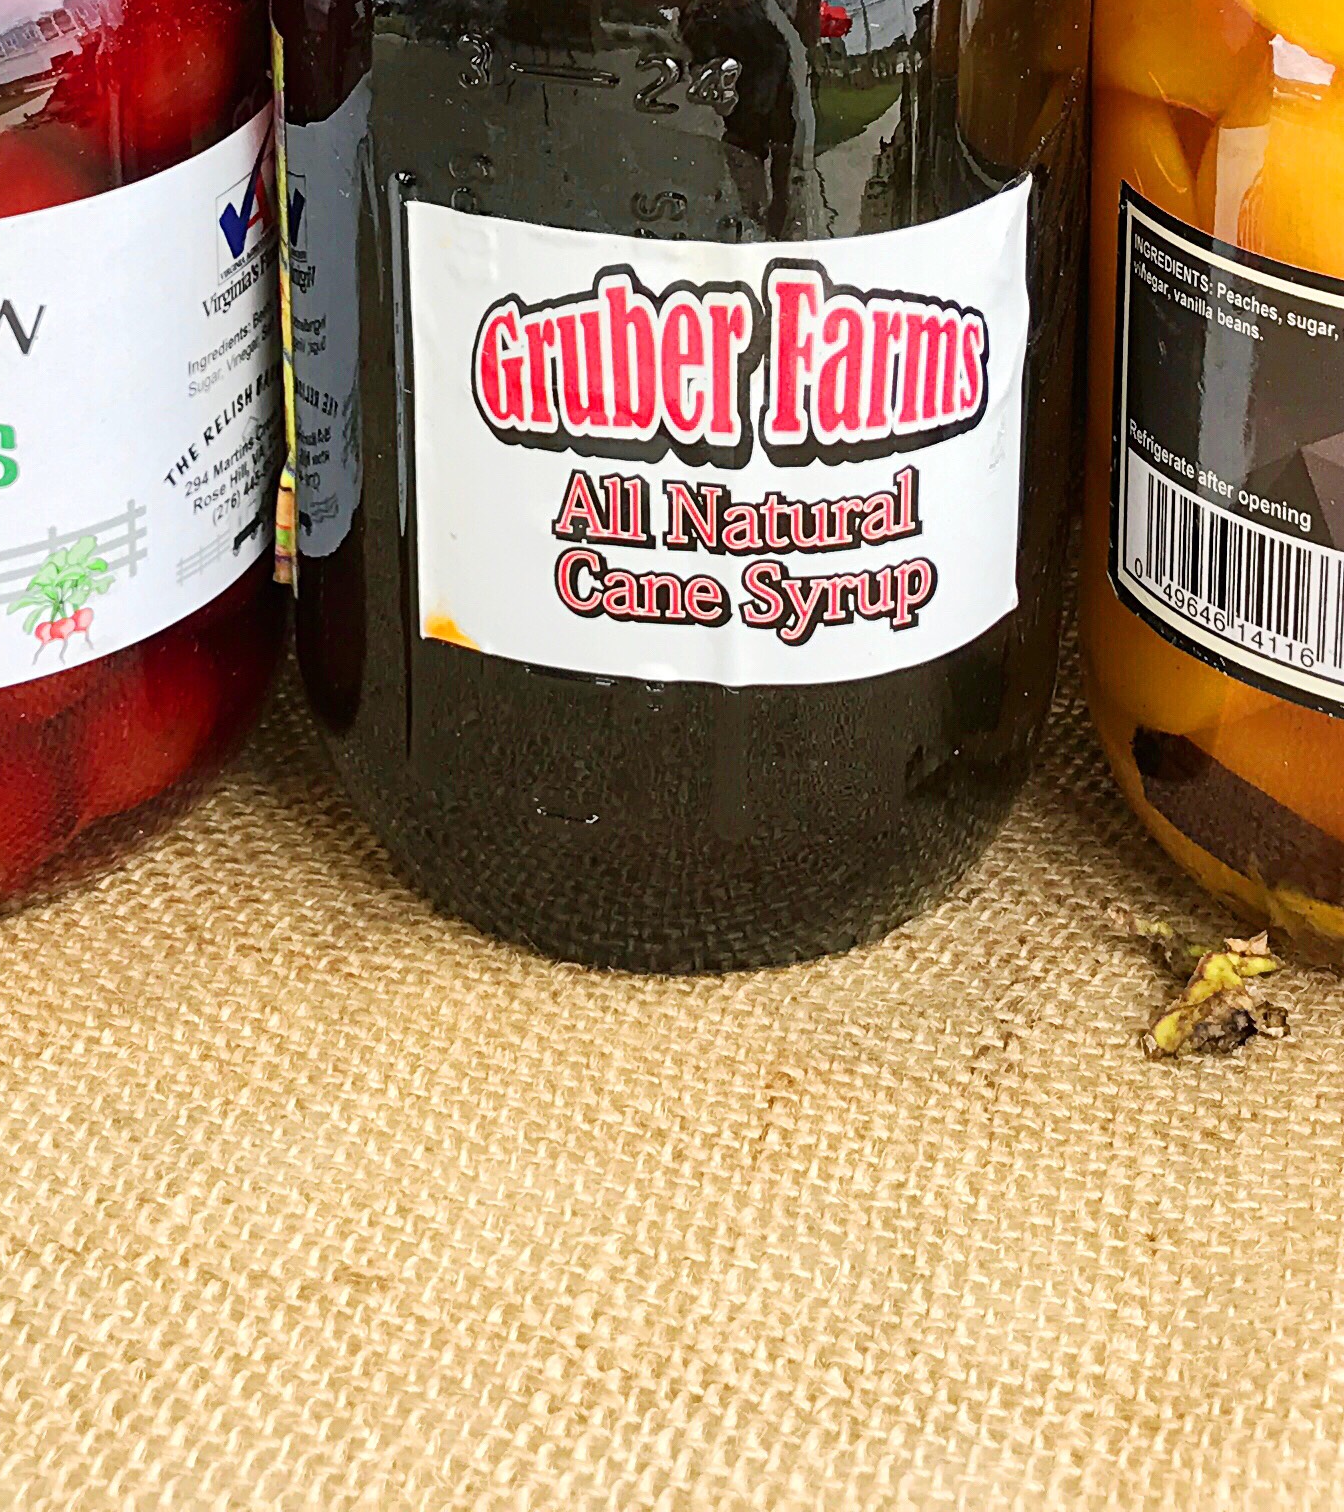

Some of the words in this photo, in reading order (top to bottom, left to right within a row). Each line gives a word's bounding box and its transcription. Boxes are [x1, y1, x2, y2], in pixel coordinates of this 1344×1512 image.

[1134, 232, 1214, 296] INGREDIENTS:
[1216, 281, 1283, 326] Peaches,
[1286, 310, 1340, 341] sugar,
[1173, 286, 1213, 321] vanilla
[1216, 306, 1265, 341] beans.
[187, 322, 252, 376] Ingredients:
[474, 273, 756, 448] Gruber
[766, 270, 988, 446] Farms
[163, 443, 200, 487] THE
[203, 383, 253, 446] RELISH
[184, 470, 209, 498] 294
[212, 436, 254, 479] Martins
[1128, 418, 1195, 479] Refrigerate
[1198, 467, 1235, 499] after
[1238, 488, 1312, 533] opening
[192, 484, 226, 515] Rose
[212, 489, 241, 527] (276)
[554, 471, 652, 546] All
[664, 466, 920, 552] Natural
[555, 549, 729, 623] Cane
[742, 558, 937, 643] Syrup
[1134, 557, 1144, 579] 0
[1162, 582, 1227, 633] 49646
[1237, 623, 1315, 669] 14116
